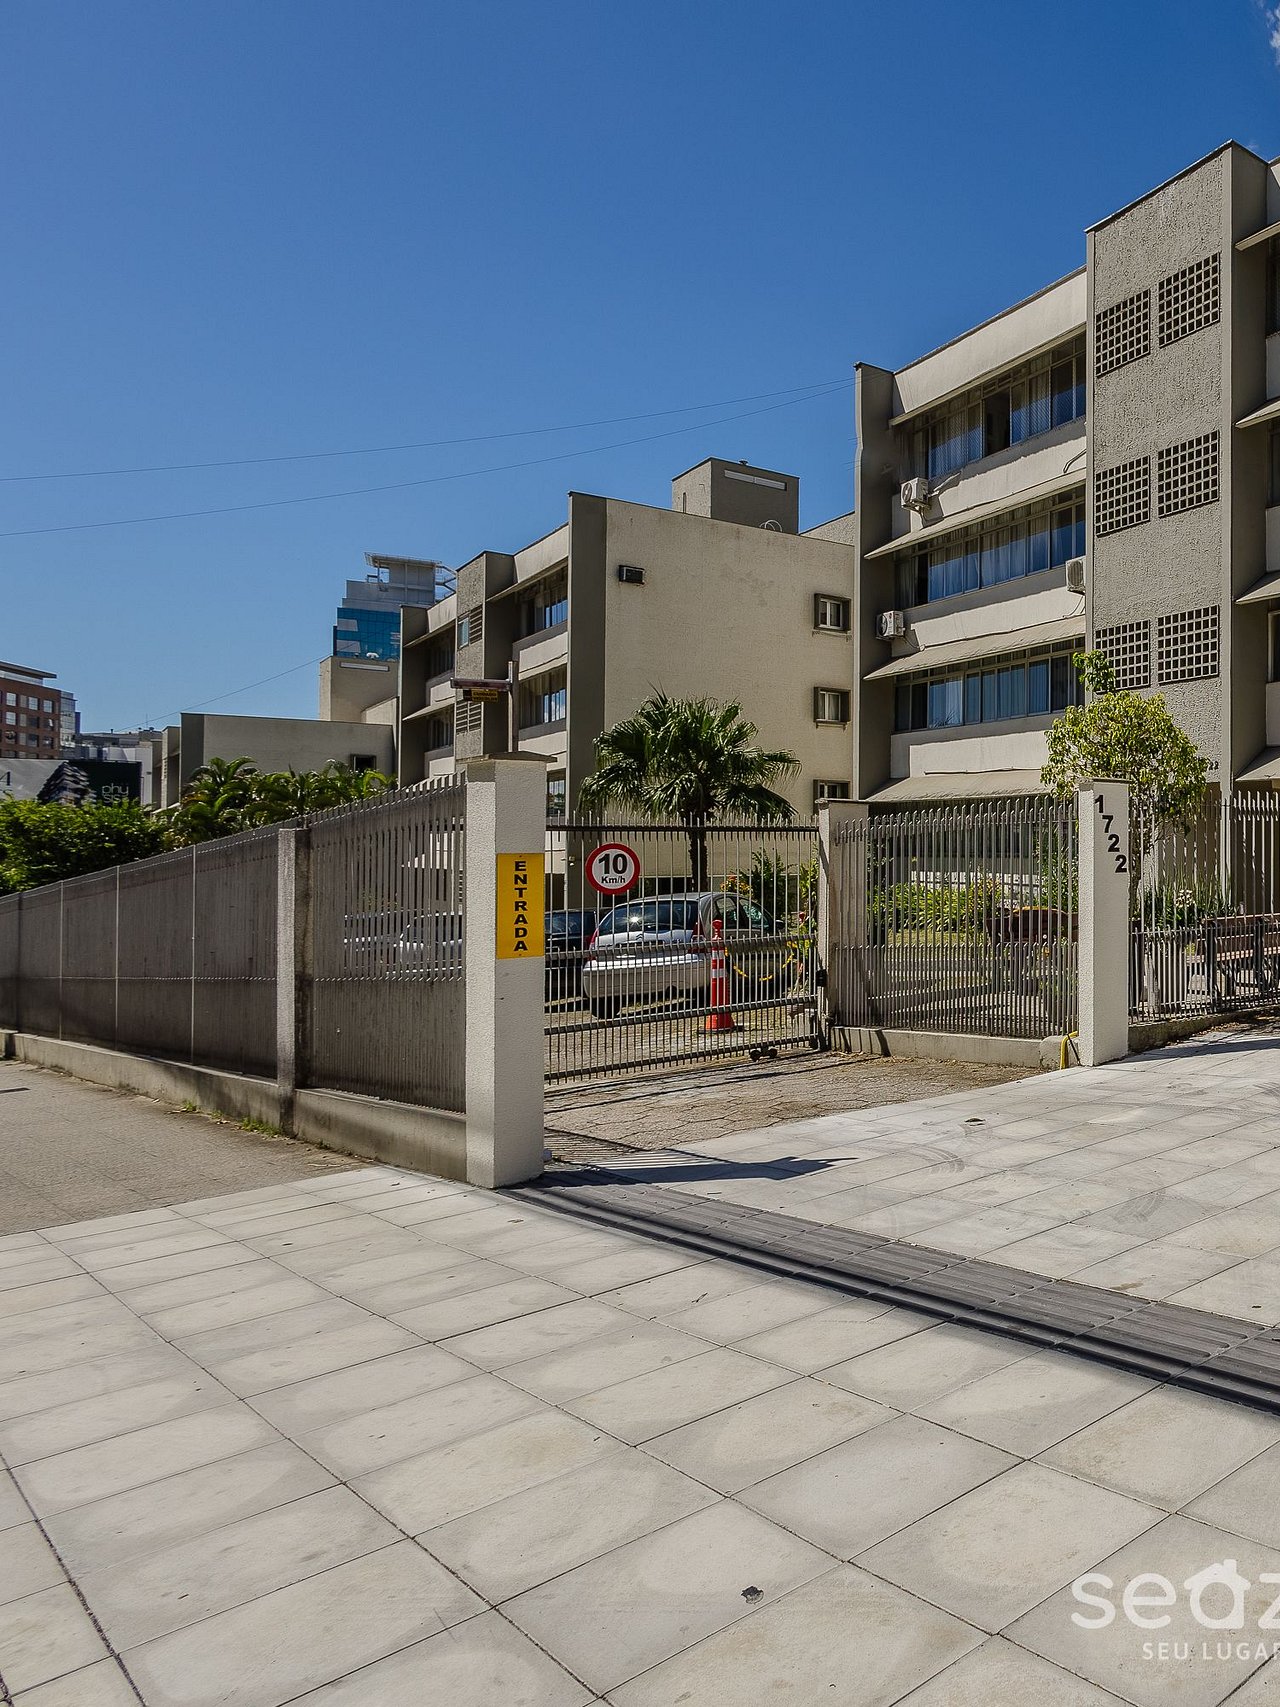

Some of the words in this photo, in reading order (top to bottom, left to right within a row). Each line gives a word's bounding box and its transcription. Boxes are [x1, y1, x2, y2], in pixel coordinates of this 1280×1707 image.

[1094, 794, 1128, 874] 1722
[598, 853, 628, 875] 10
[601, 875, 626, 885] Km/h
[513, 860, 529, 952] ENTRADA
